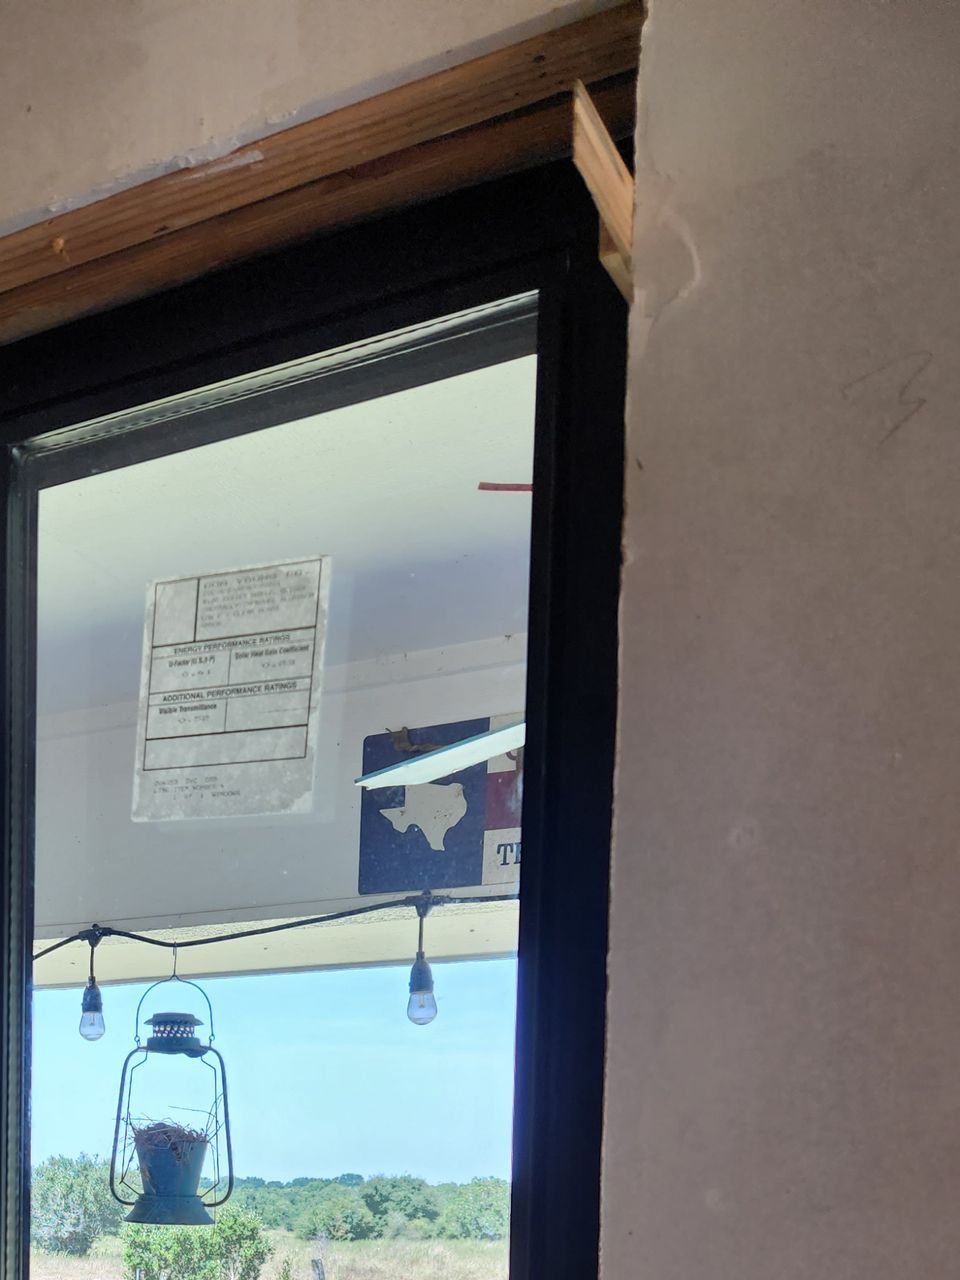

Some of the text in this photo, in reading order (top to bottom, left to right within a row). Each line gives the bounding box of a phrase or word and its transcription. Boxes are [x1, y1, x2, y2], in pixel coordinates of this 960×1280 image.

[203, 639, 257, 650] PERFORMANCE
[259, 634, 290, 643] RATINGS
[162, 681, 297, 702] ADDITIONAL PERFORMANCE RATINGS
[179, 703, 217, 713] Transmittance
